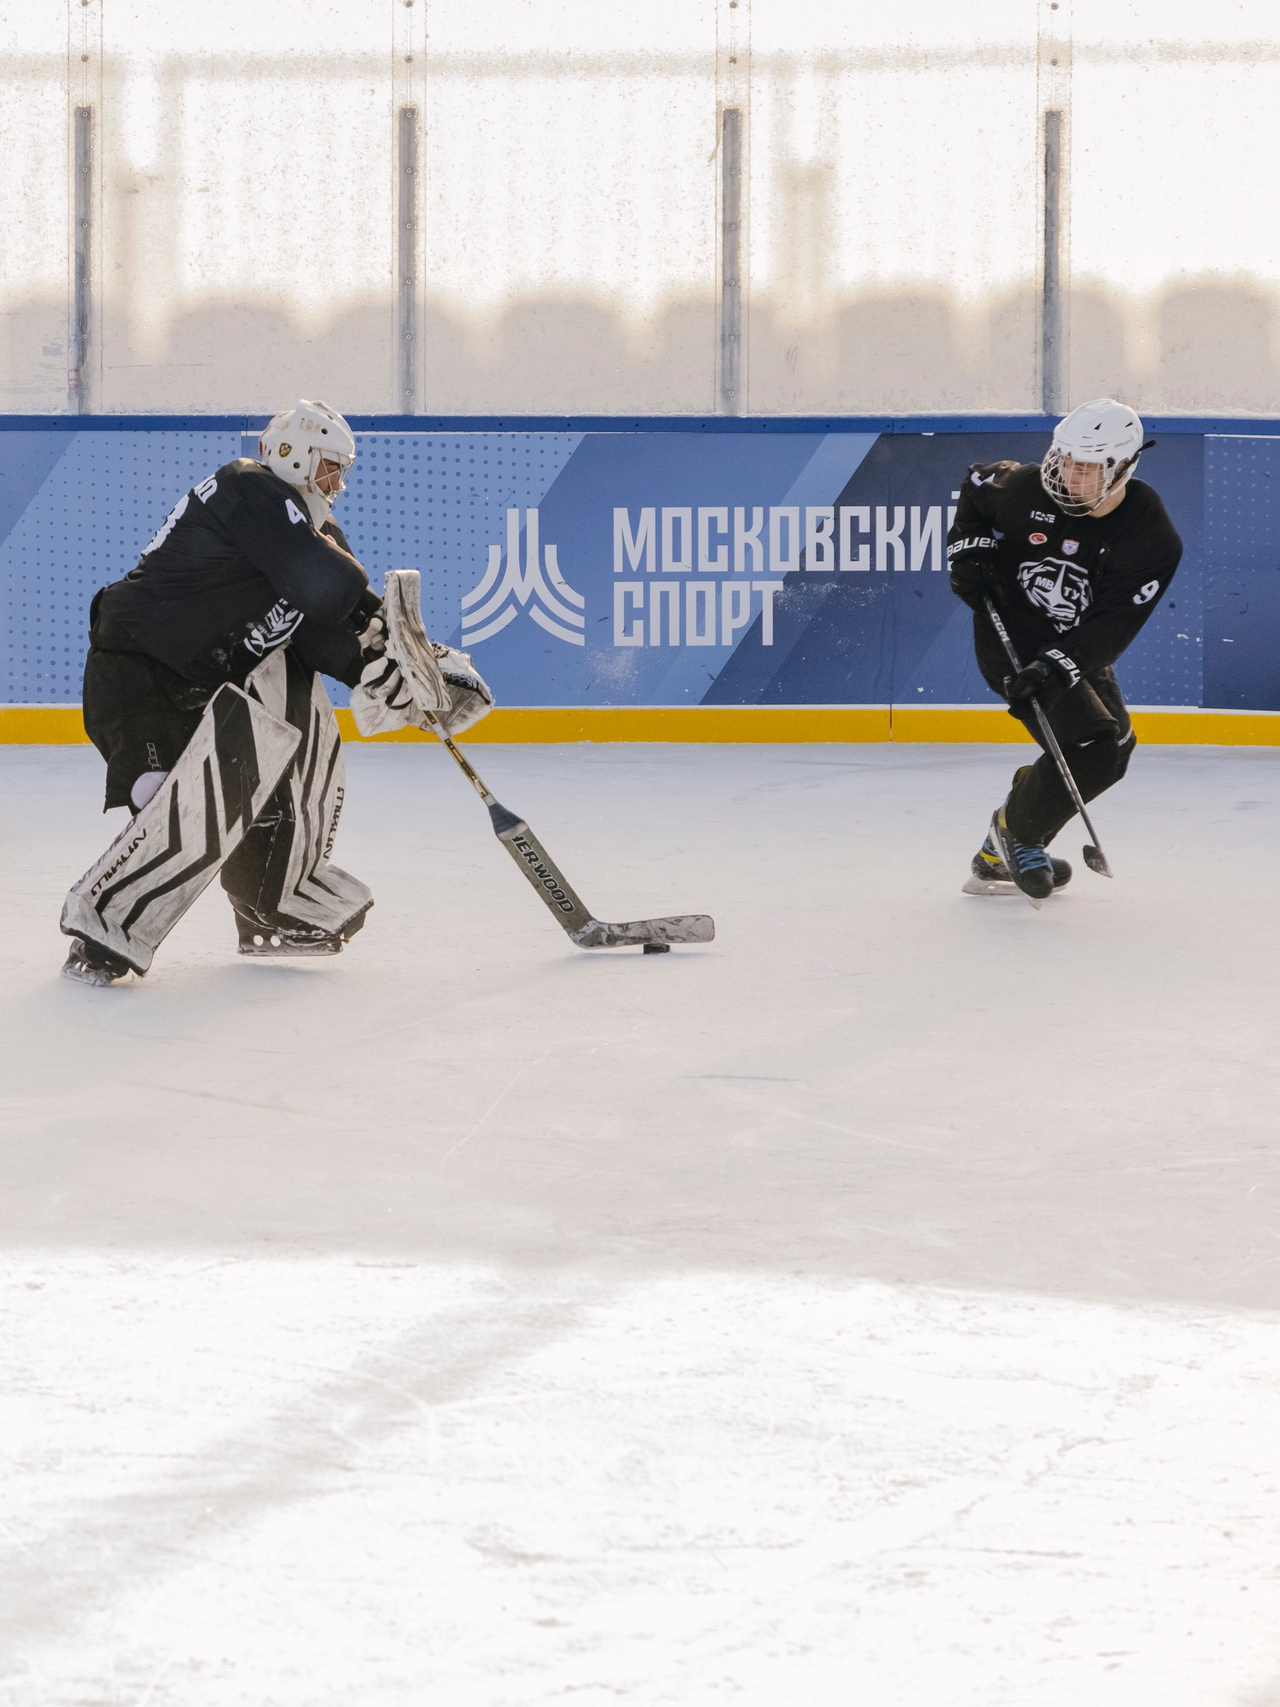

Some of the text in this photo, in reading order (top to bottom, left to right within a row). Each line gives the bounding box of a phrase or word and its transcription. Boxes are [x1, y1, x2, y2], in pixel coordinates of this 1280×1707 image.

[1132, 579, 1160, 605] 9
[613, 580, 784, 647] СПОРТ
[991, 612, 1011, 642] CCM
